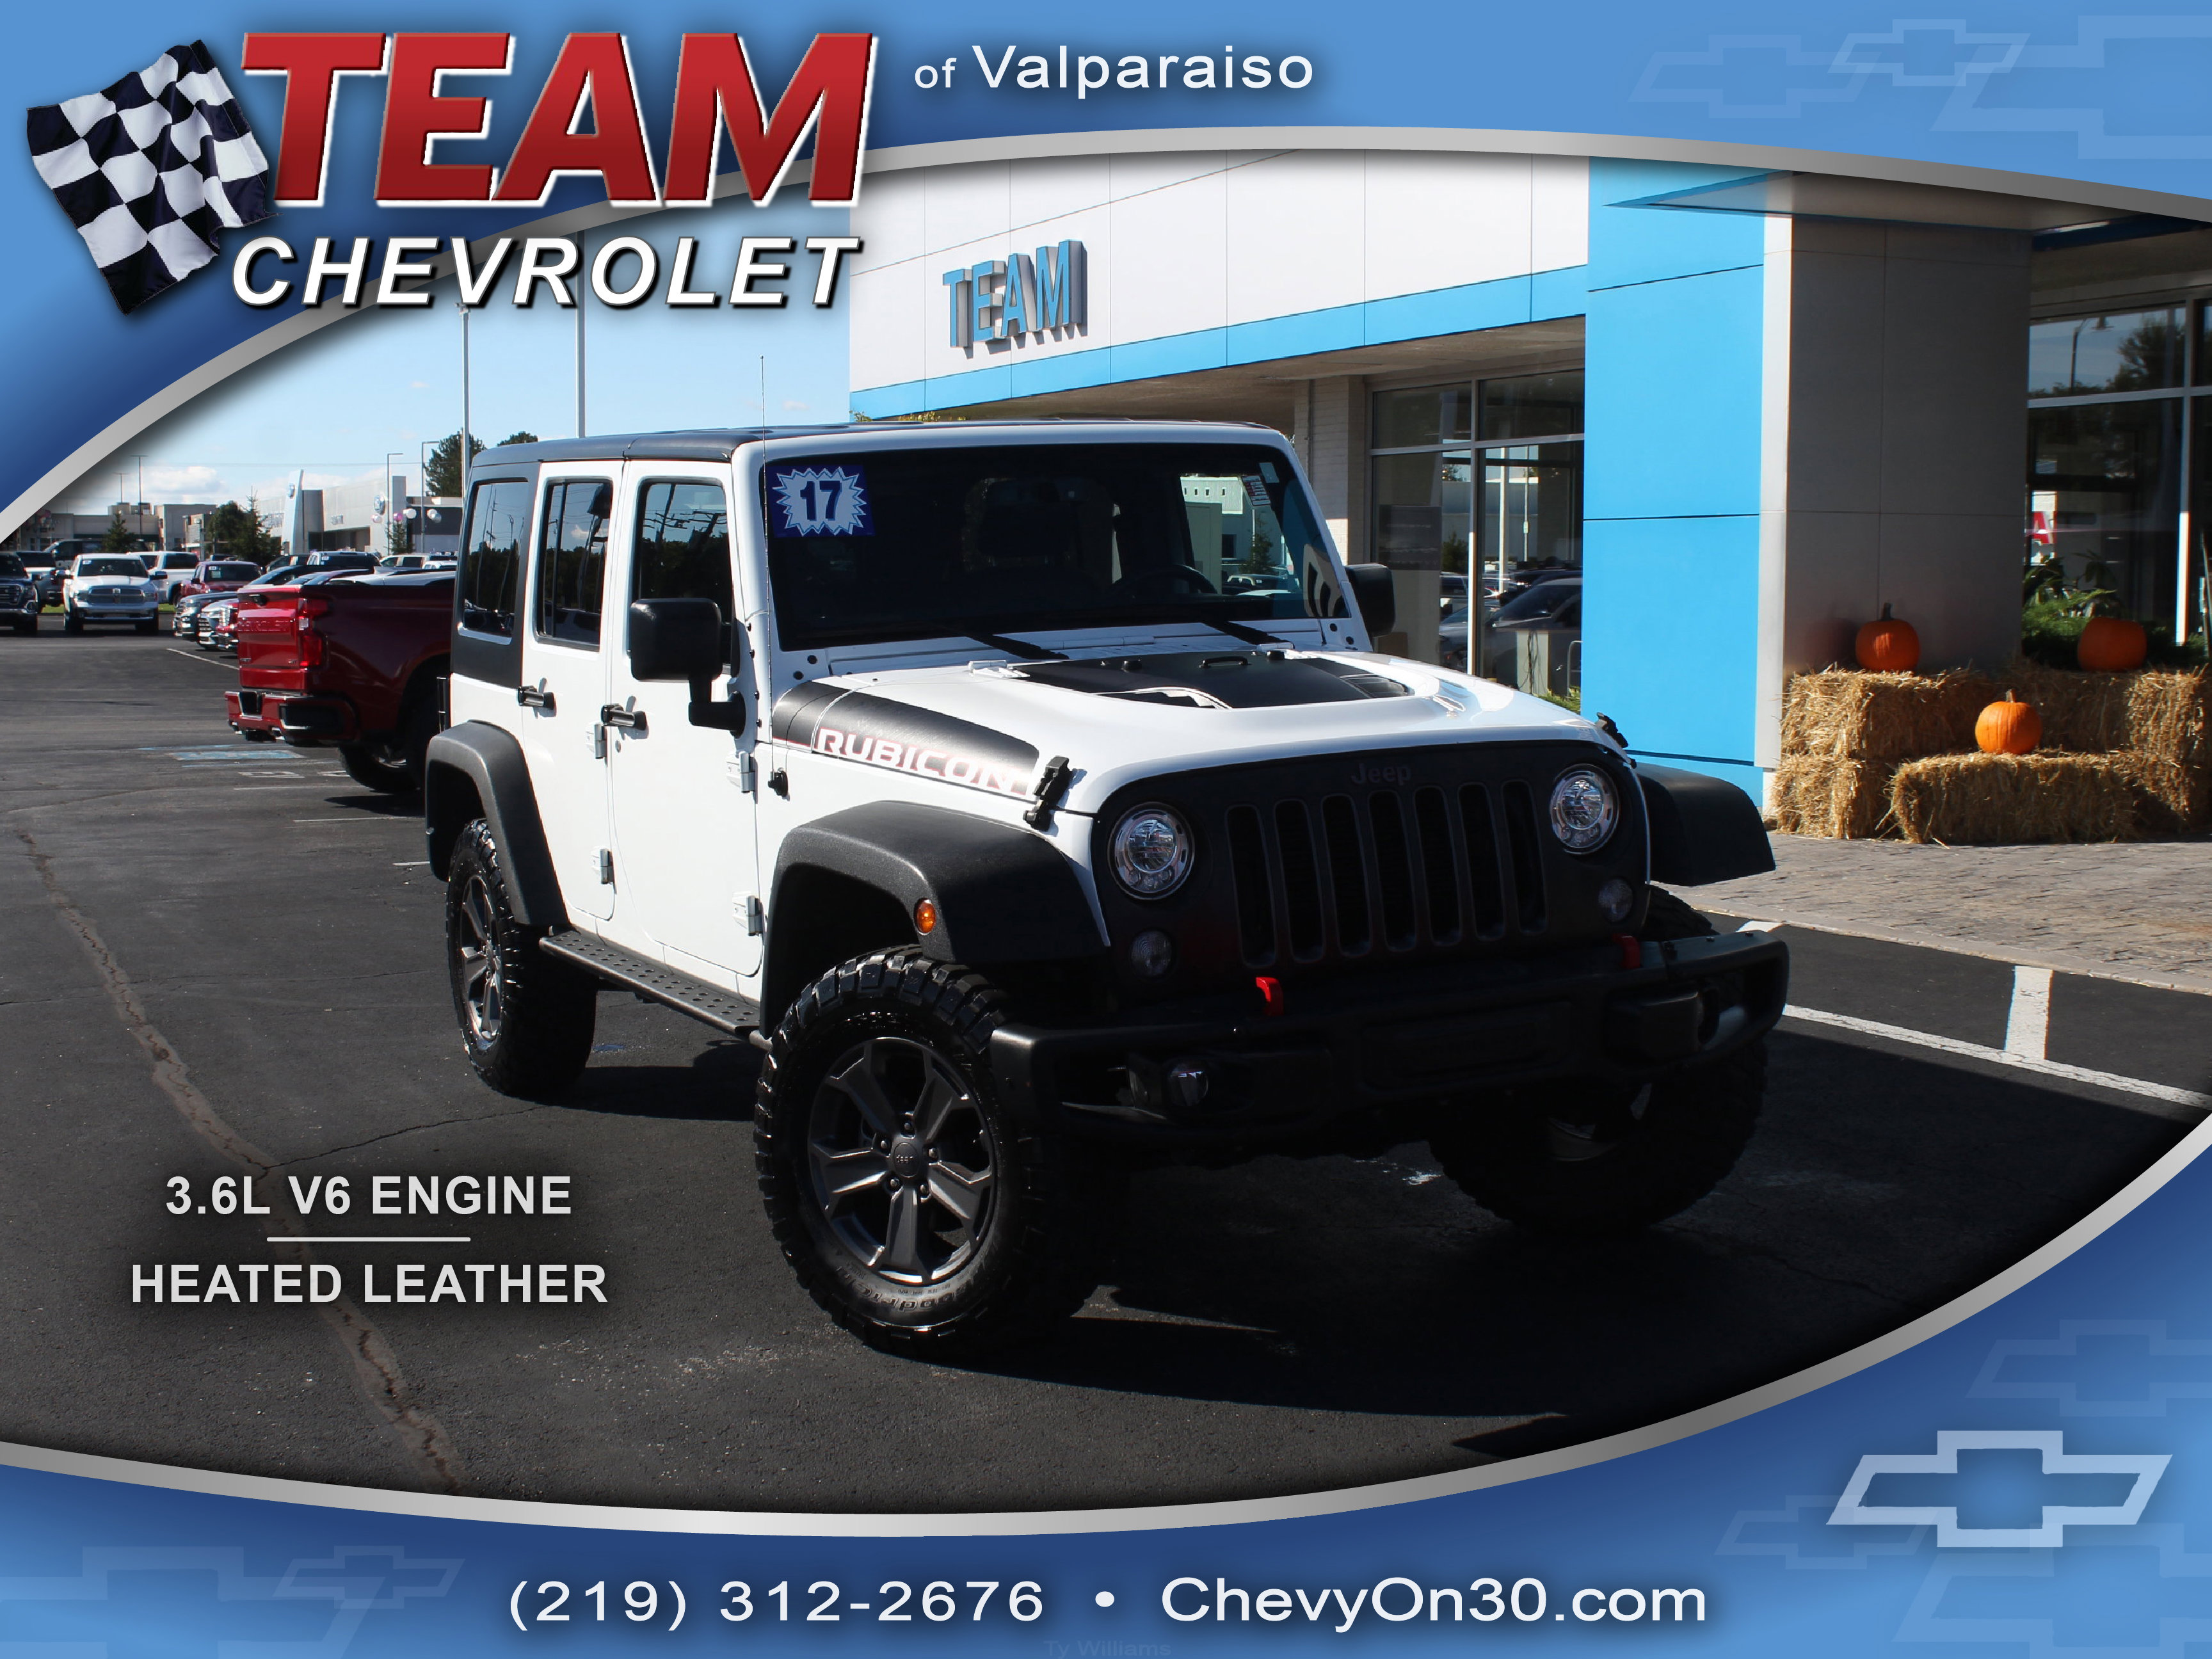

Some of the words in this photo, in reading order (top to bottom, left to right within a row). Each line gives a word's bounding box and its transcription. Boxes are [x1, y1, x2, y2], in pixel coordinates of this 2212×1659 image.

[942, 239, 1085, 348] TEAM
[800, 481, 842, 521] 17
[815, 726, 1028, 796] RUBICON
[1350, 763, 1411, 786] Jeep
